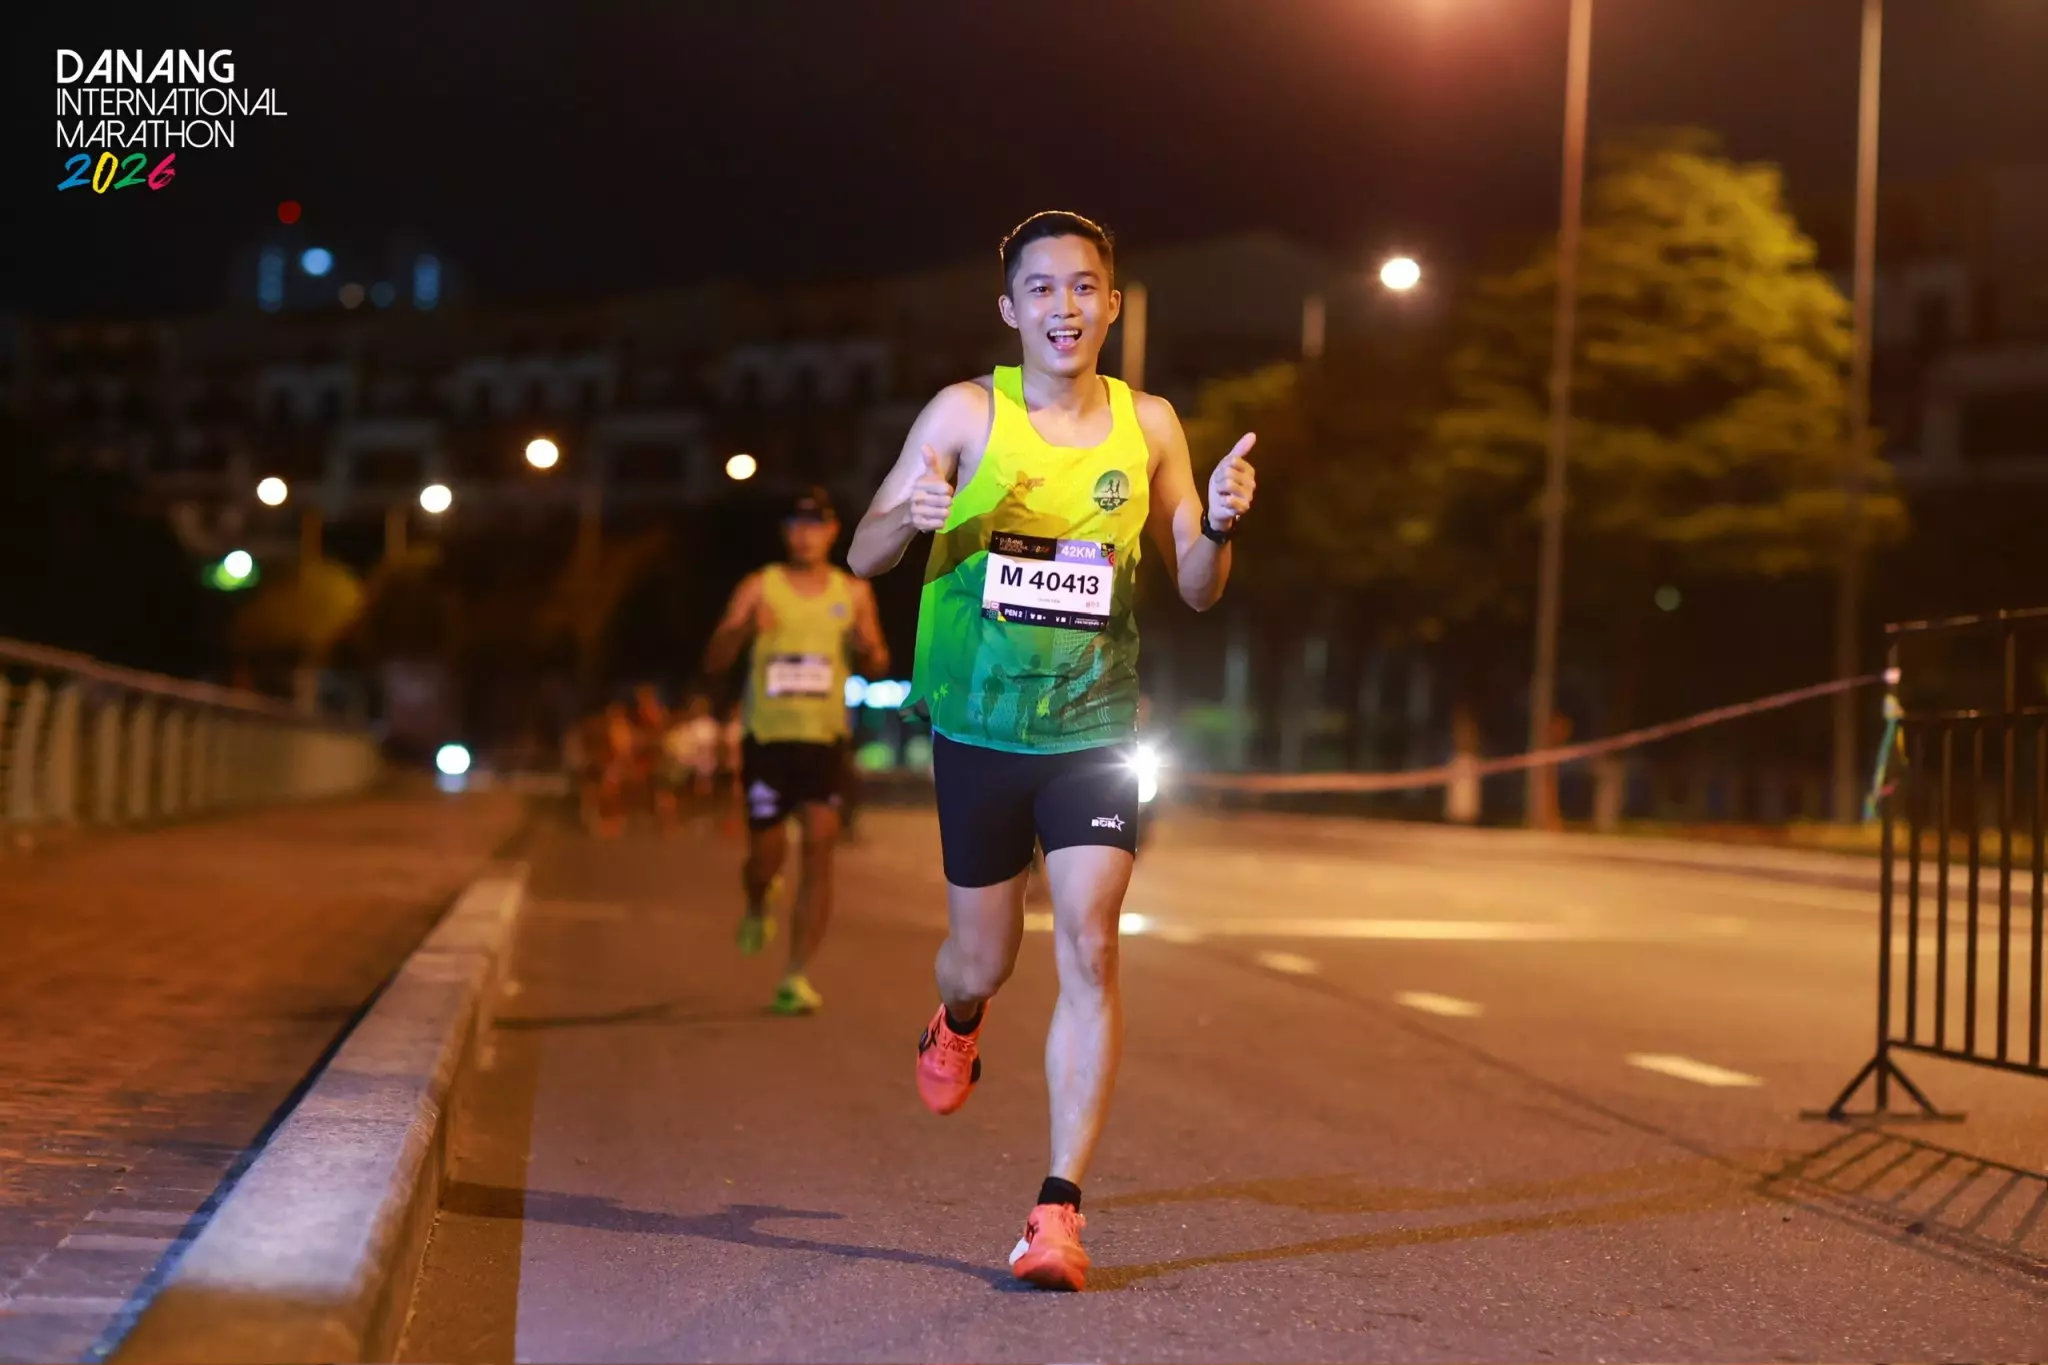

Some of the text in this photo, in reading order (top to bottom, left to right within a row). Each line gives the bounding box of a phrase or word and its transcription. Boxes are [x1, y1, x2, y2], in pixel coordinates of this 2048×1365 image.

[1061, 544, 1097, 559] 42KM
[1000, 565, 1100, 595] M 40413
[1004, 608, 1018, 617] PEN
